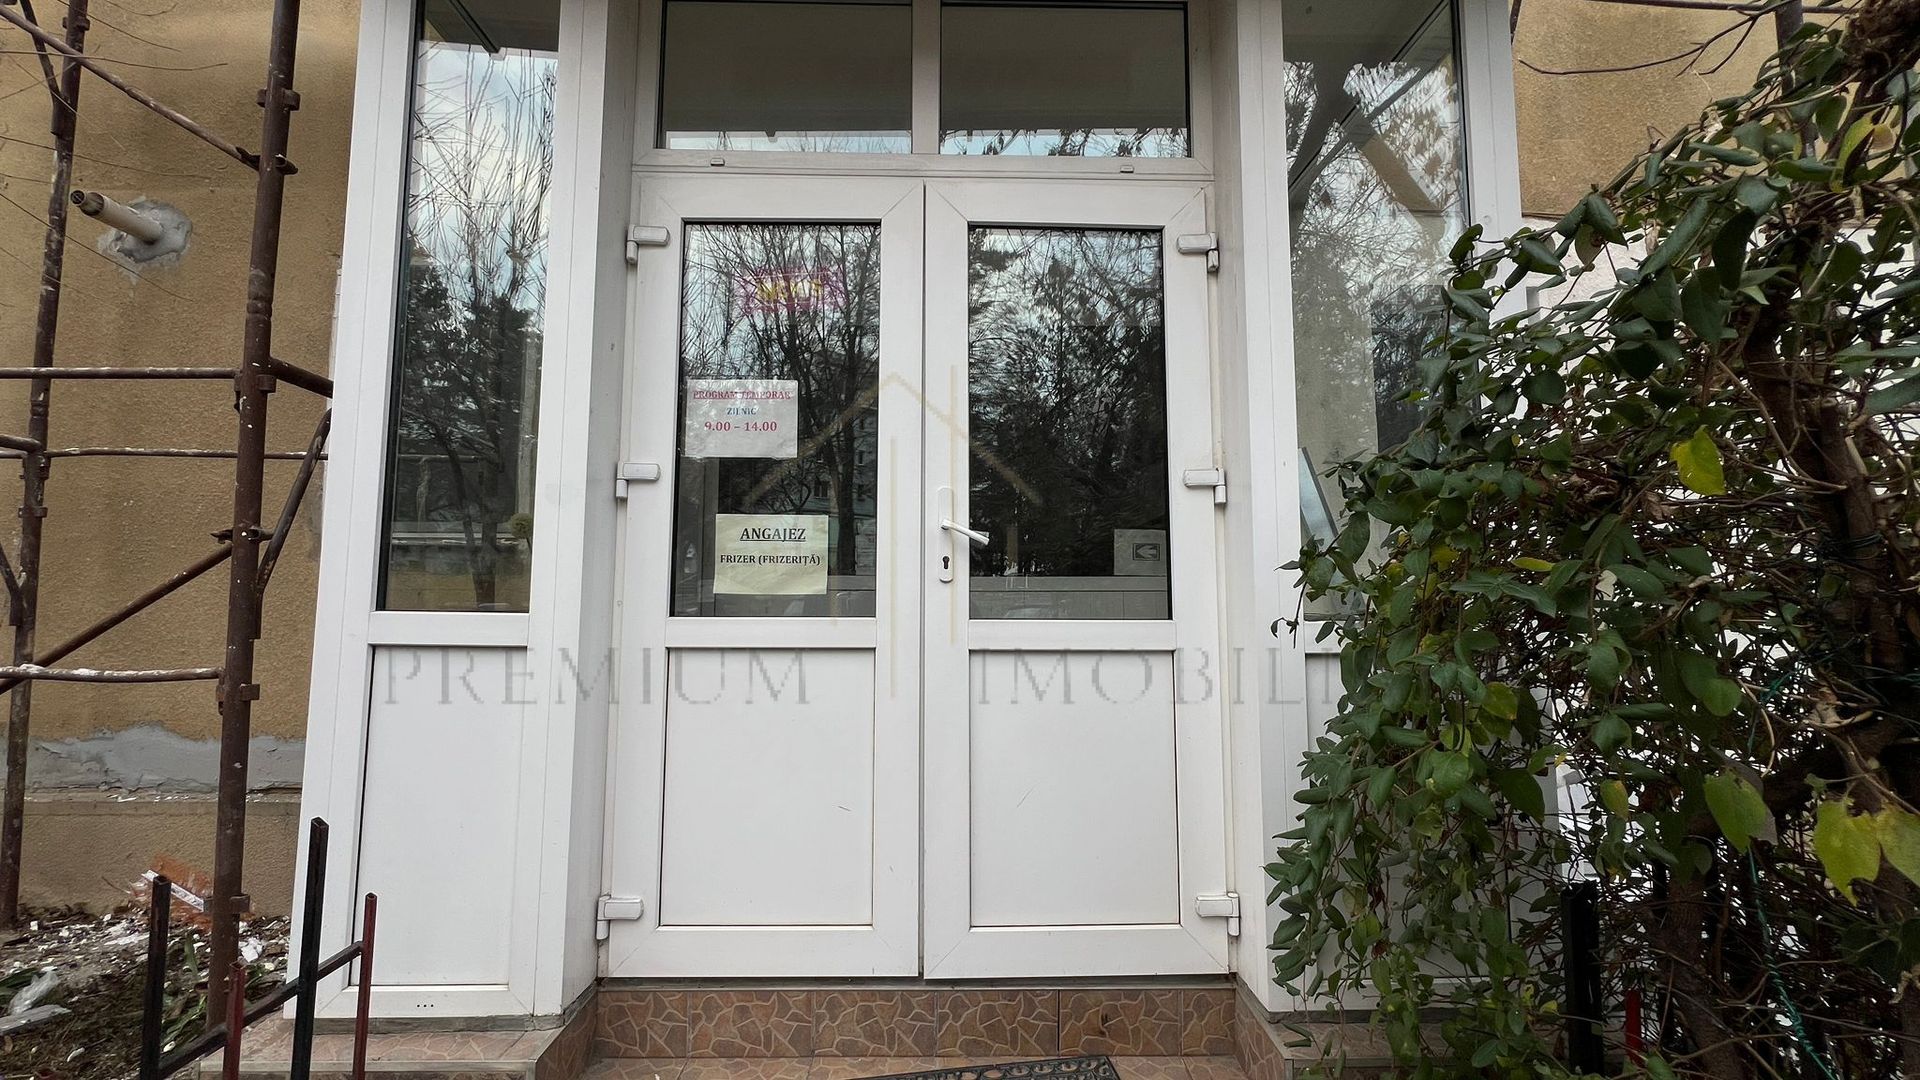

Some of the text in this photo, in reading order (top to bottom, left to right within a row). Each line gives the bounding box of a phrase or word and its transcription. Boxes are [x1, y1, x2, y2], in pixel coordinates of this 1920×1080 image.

[704, 421, 731, 432] 9.00
[743, 421, 778, 432] 14.00
[740, 527, 807, 542] ANGAJEZ
[720, 554, 756, 564] FRIZER
